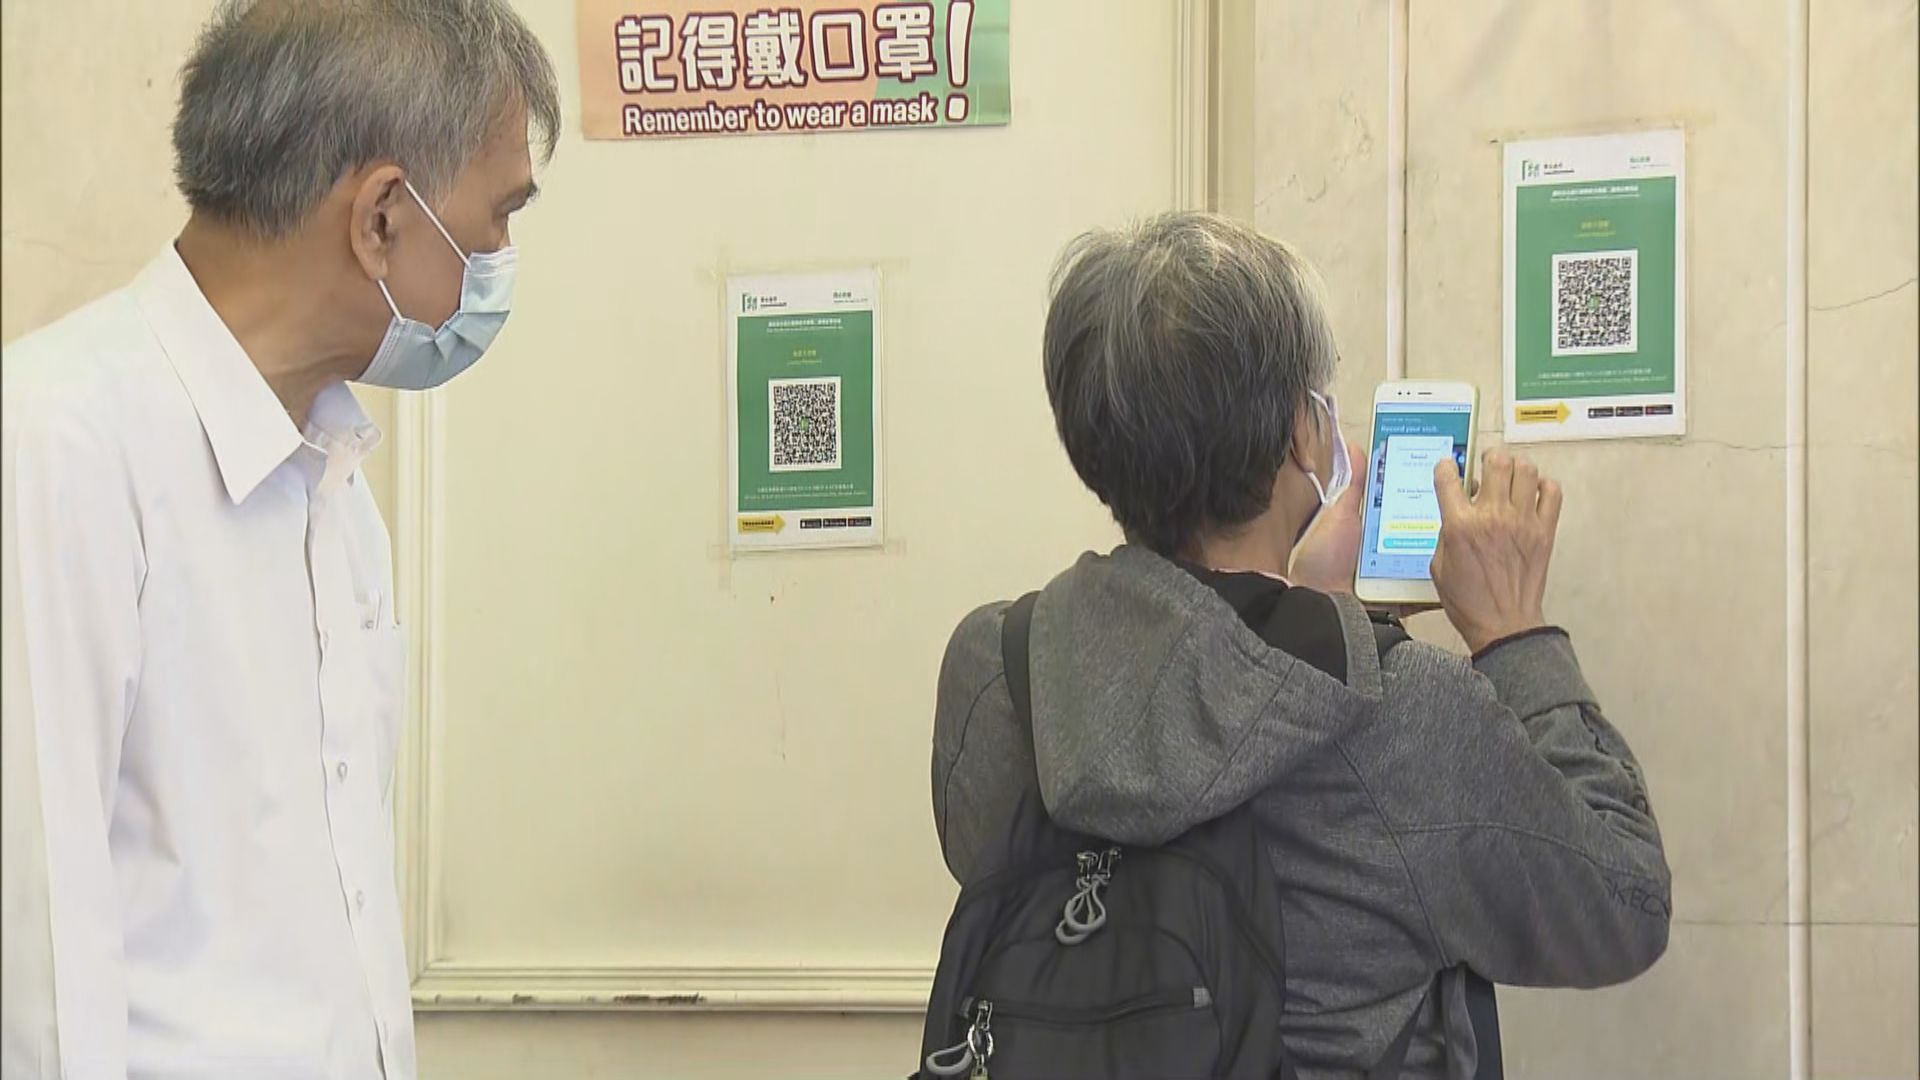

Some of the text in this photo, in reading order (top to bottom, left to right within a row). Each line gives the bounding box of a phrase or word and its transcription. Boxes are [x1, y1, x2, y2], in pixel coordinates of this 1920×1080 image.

[623, 92, 938, 134] Remember to wear a mask
[1381, 424, 1405, 432] Record
[1406, 425, 1420, 433] your
